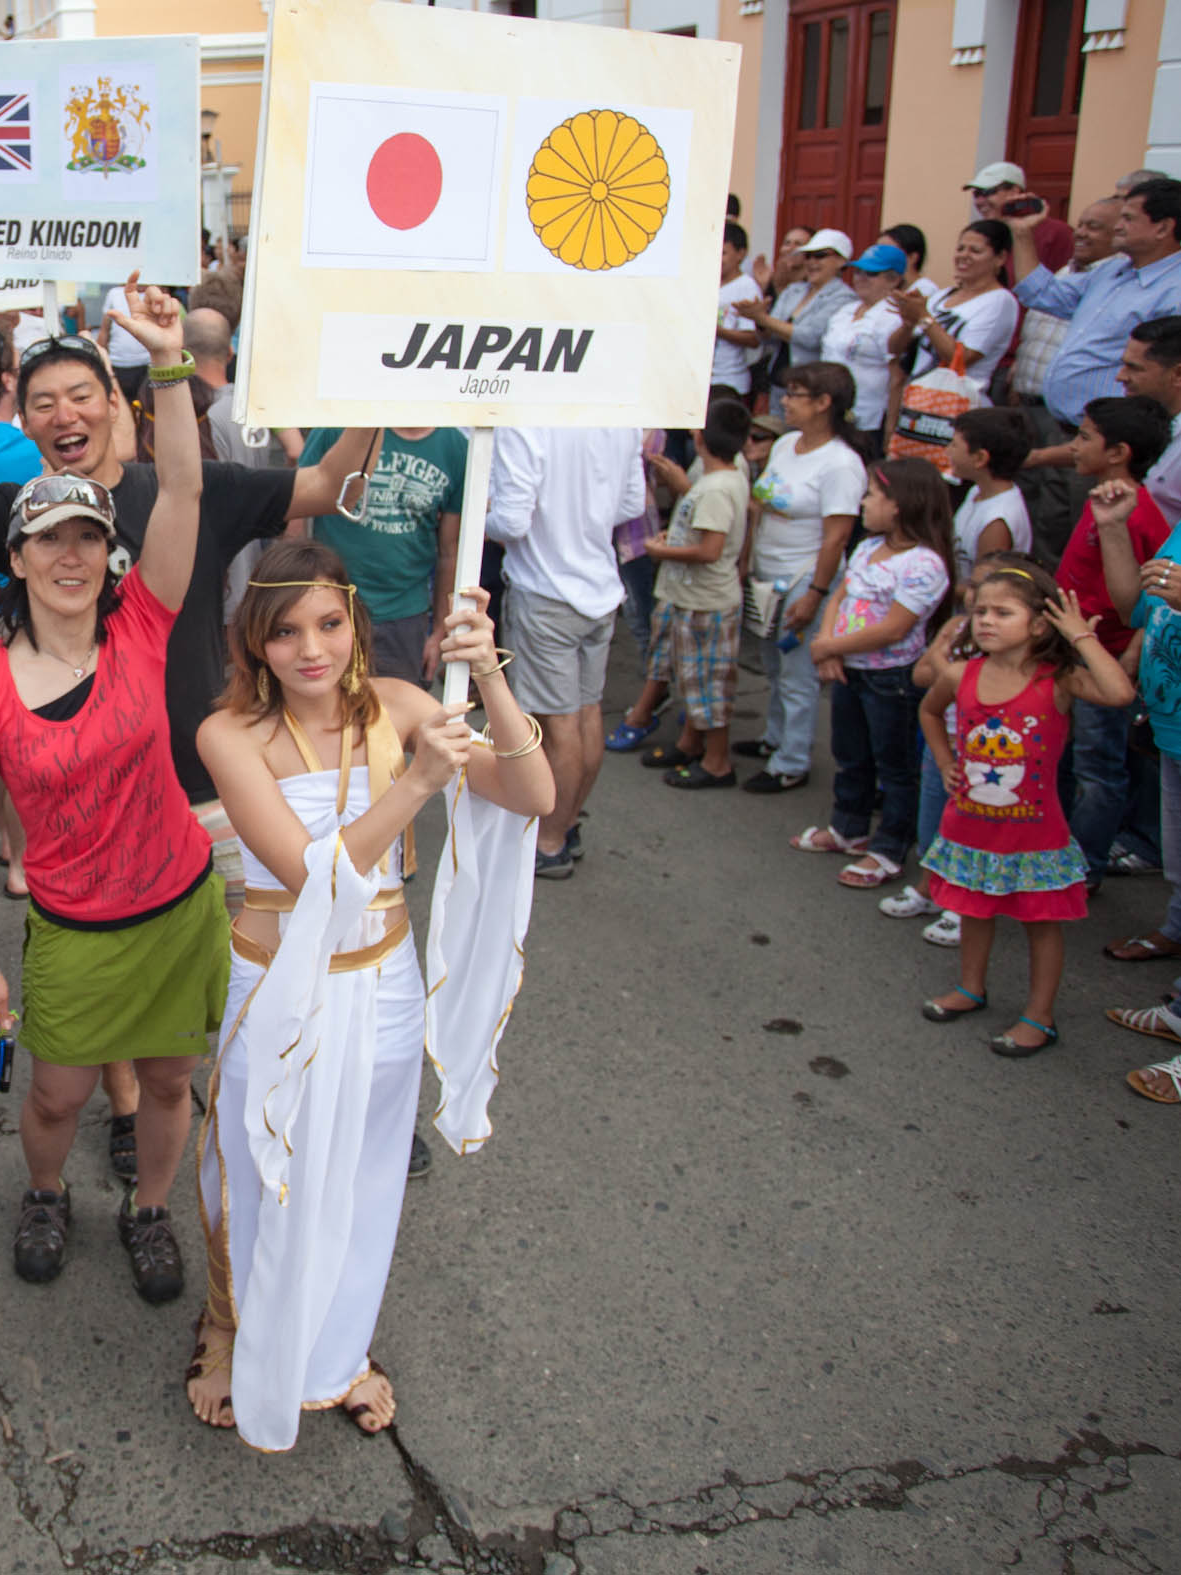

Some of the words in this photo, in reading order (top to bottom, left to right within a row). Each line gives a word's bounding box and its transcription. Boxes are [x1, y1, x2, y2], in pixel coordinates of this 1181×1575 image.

[29, 220, 141, 248] KINGDOM
[6, 247, 38, 260] Reino
[40, 248, 72, 261] Unido
[381, 322, 595, 373] JAPAN
[459, 374, 511, 398] Japón
[374, 450, 450, 497] LFIGER
